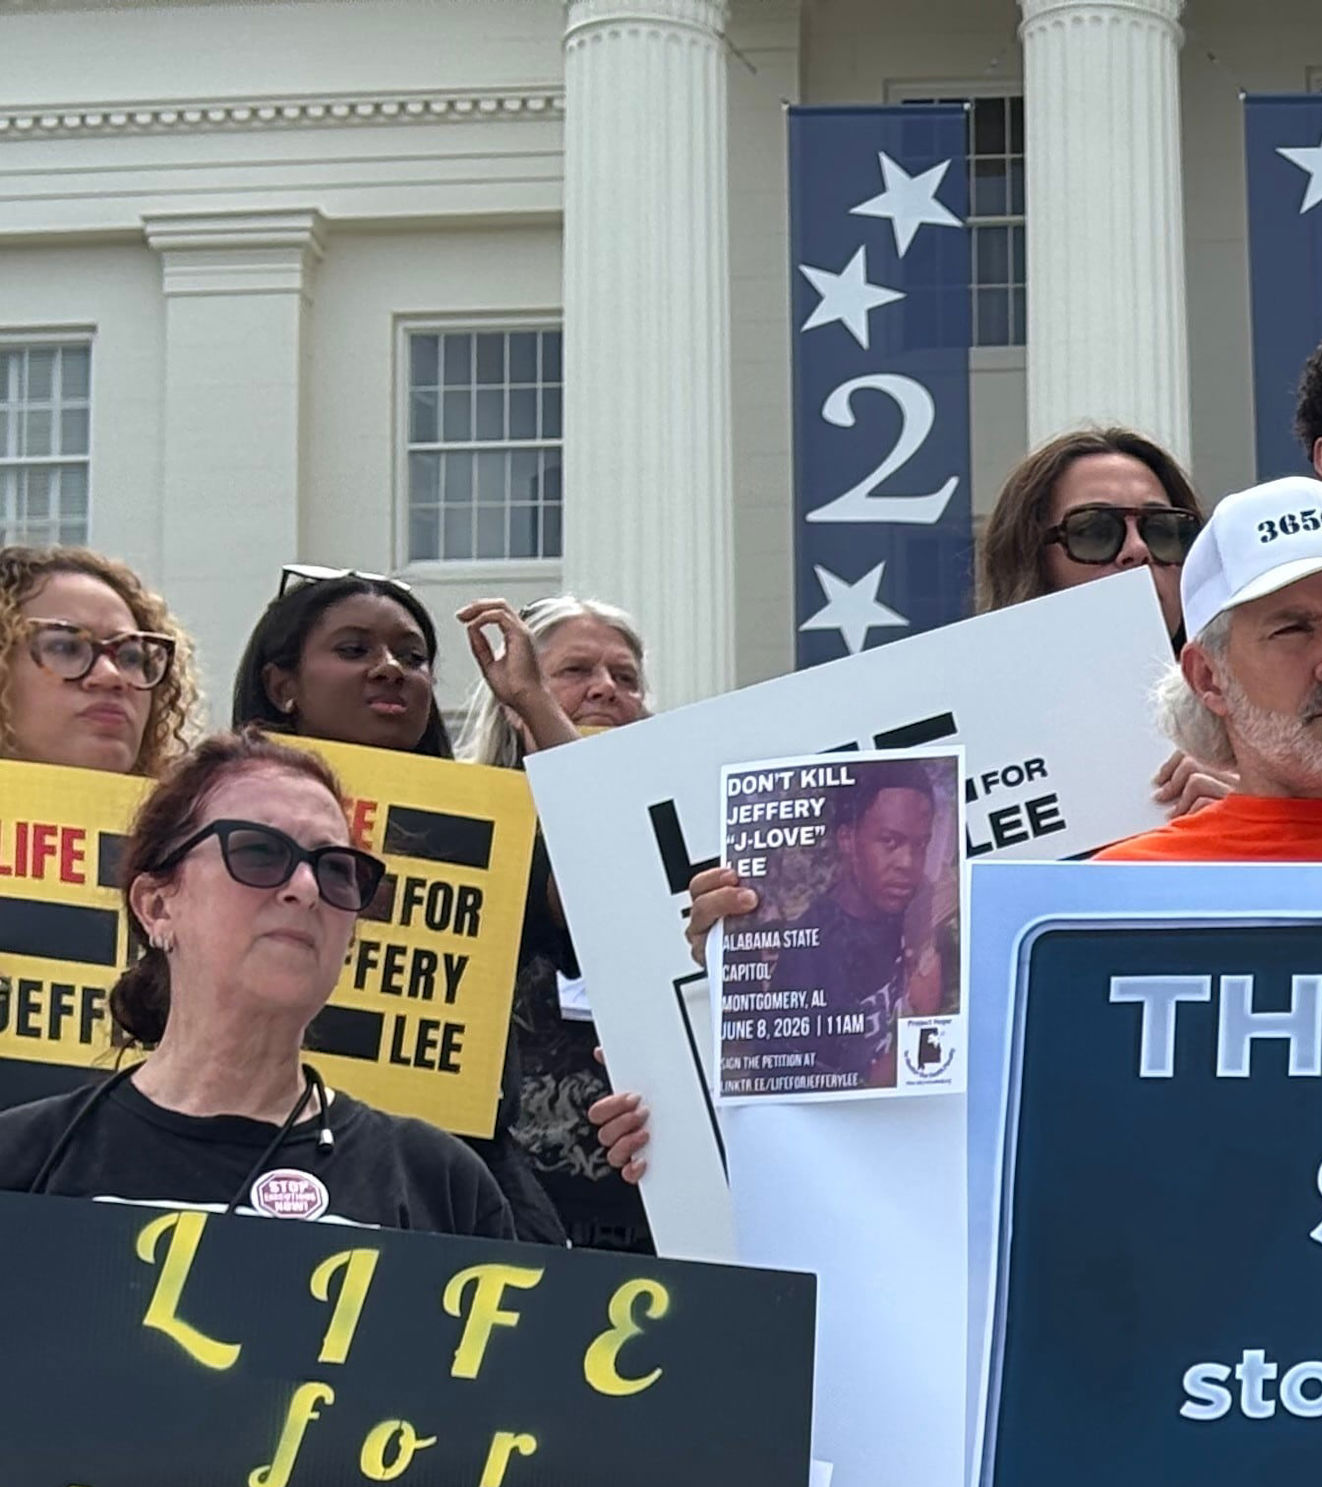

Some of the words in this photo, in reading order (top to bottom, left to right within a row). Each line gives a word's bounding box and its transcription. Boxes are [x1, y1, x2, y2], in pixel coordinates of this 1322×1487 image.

[806, 373, 958, 523] 2
[800, 766, 855, 788] KILL
[981, 757, 1048, 795] FOR
[727, 798, 825, 825] JEFFERY
[400, 876, 483, 938] FOR
[723, 931, 780, 950] ALABAMA
[783, 928, 820, 947] STATE
[723, 962, 771, 981] CAPITOL
[722, 991, 808, 1012] MONTGOMERY,
[811, 990, 826, 1007] AL
[721, 1019, 753, 1040] JUNE
[757, 1019, 770, 1040] 8,
[774, 1017, 810, 1037] 2026
[828, 1013, 864, 1034] 11AM
[389, 1014, 465, 1074] LEE
[743, 1055, 759, 1068] THE
[762, 1053, 801, 1068] PETITION
[804, 1052, 816, 1066] AT
[134, 1210, 671, 1397] LIFE
